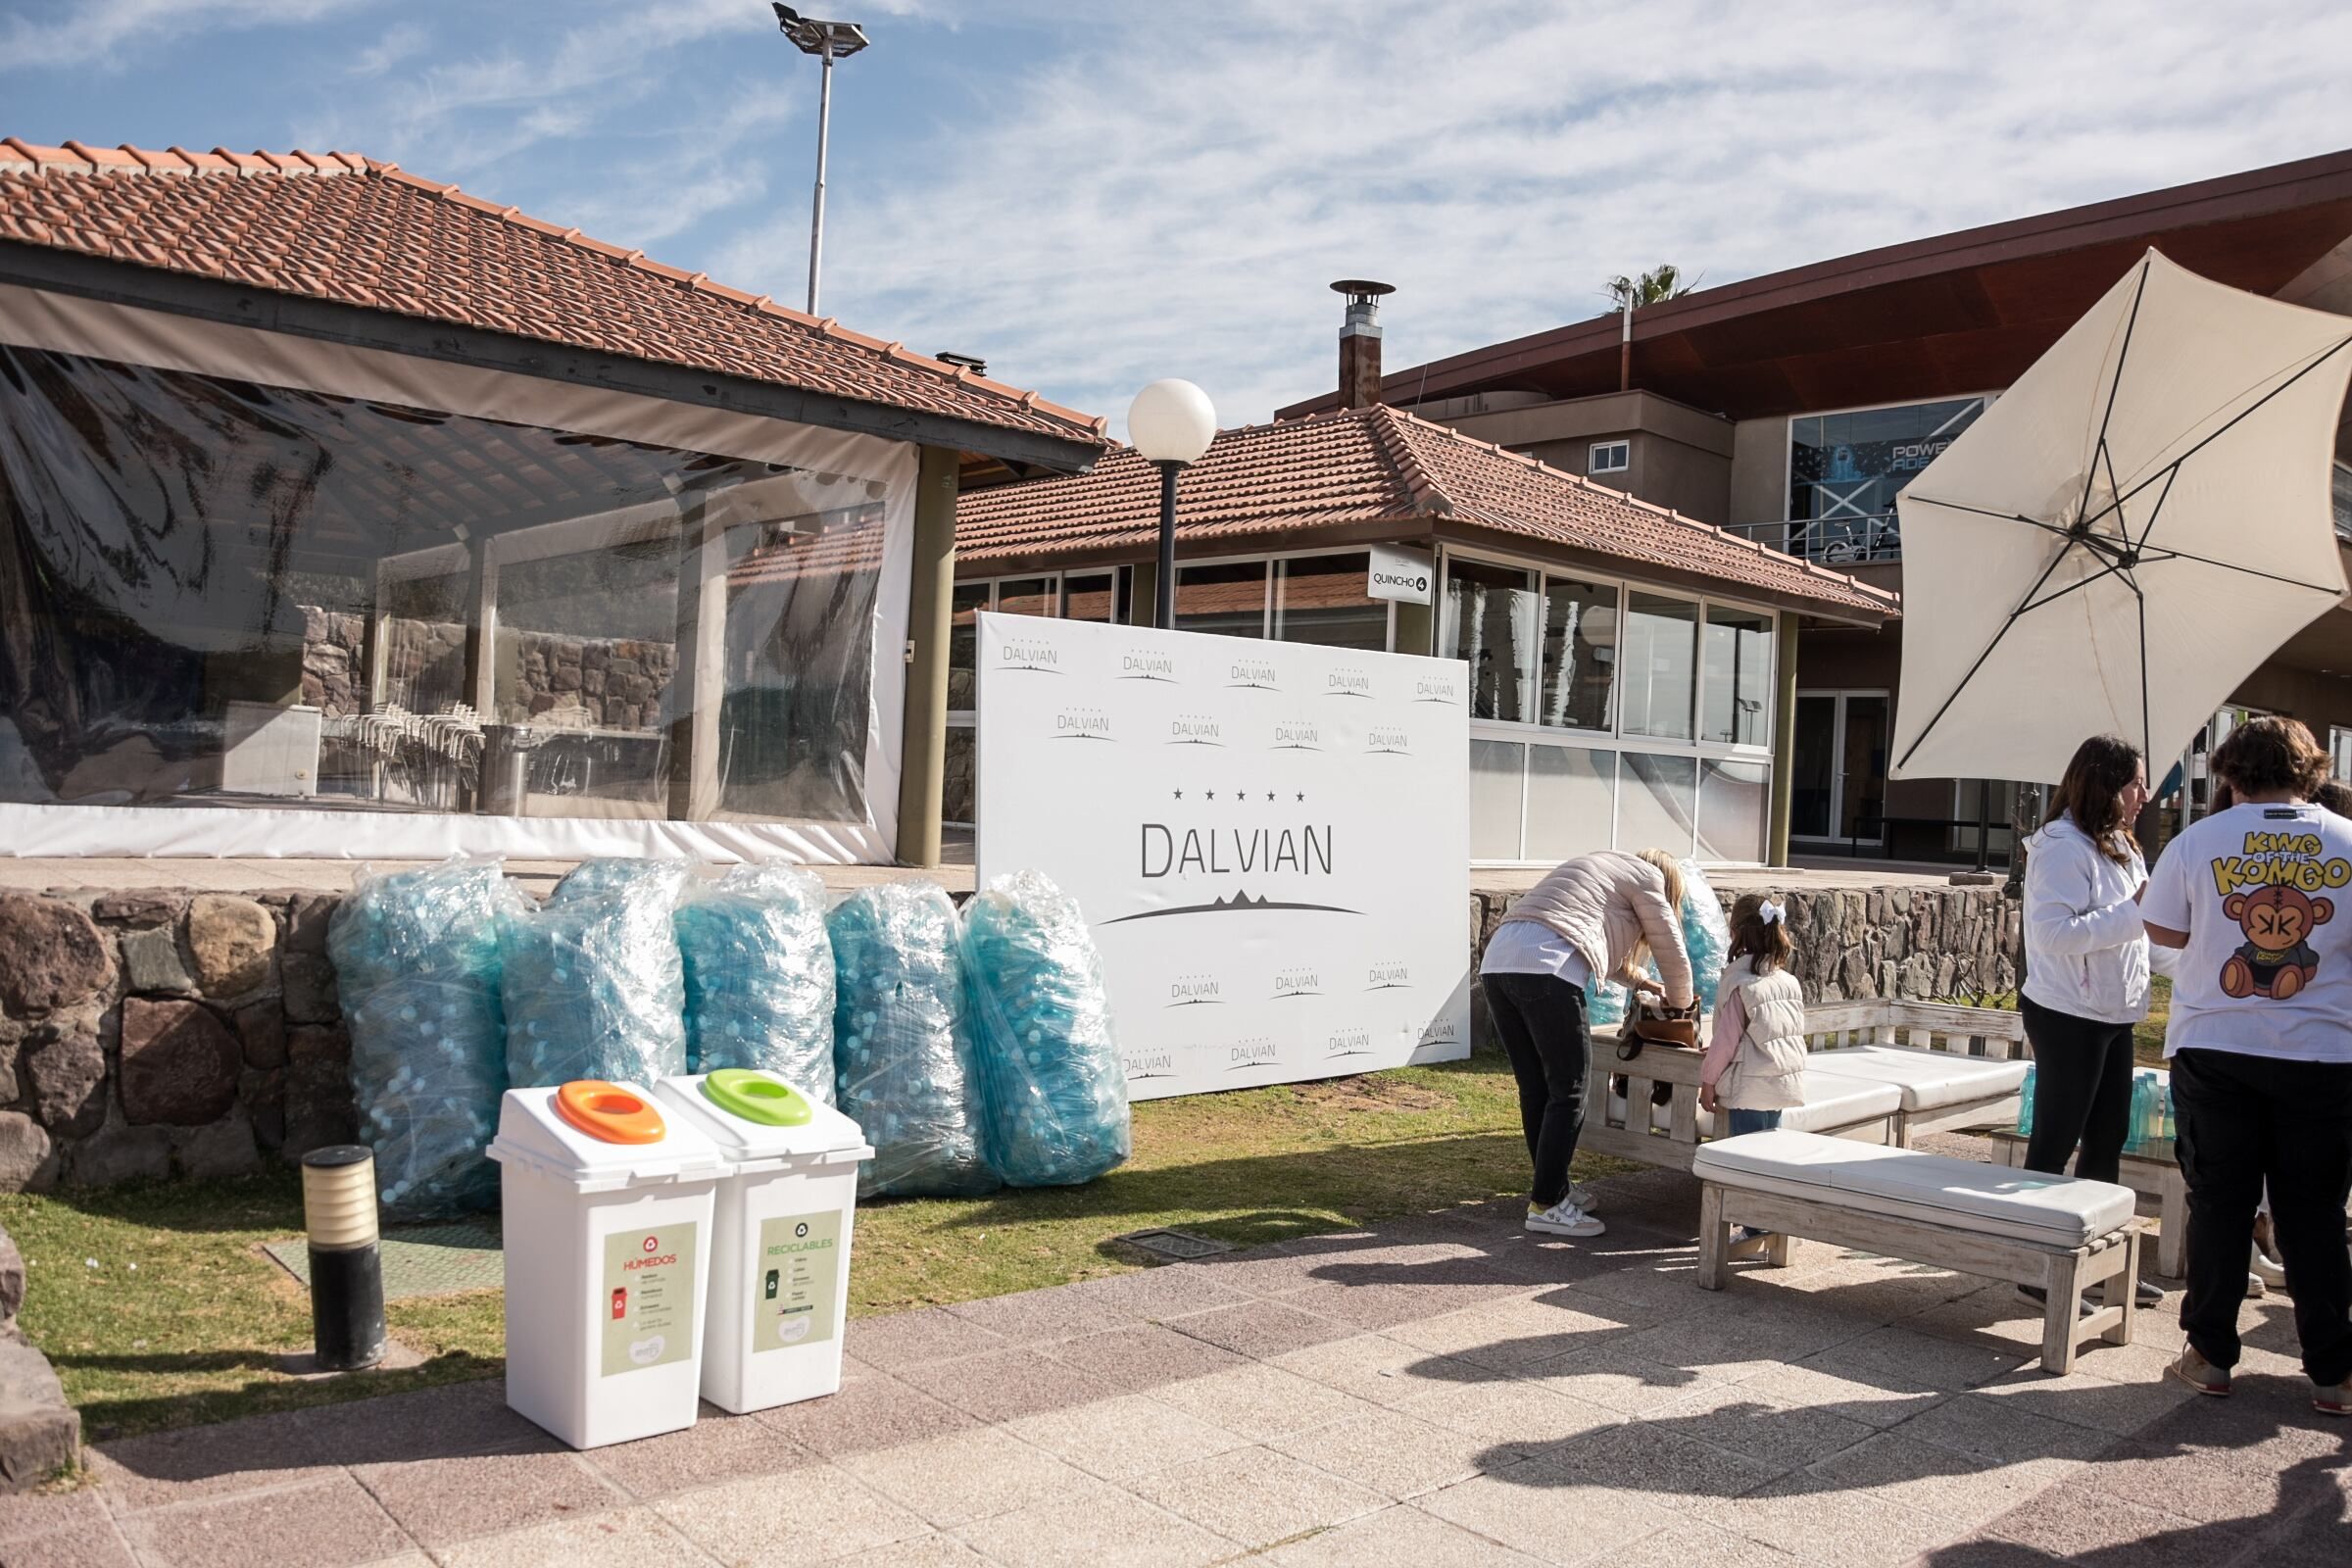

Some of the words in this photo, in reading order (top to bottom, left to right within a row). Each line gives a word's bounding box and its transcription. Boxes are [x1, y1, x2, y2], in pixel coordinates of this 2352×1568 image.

[1892, 442, 1950, 459] POWE
[1892, 457, 1930, 470] ADE
[1373, 572, 1414, 588] QUINCHO
[1417, 578, 1426, 590] 4
[1003, 645, 1057, 665] DALVIAN
[1123, 655, 1172, 675] DALVIAN
[1231, 664, 1276, 683] DALVIAN
[1328, 673, 1369, 691] DALVIAN
[1417, 681, 1454, 698] DALVIAN
[1057, 714, 1109, 731] DALVIAN
[1172, 721, 1219, 738] DALVIAN
[1276, 726, 1318, 743] DALVIAN
[1368, 732, 1407, 747] DALVIAN
[1142, 823, 1332, 879] DALVIAN
[2243, 831, 2322, 856] KING
[2252, 852, 2276, 864] OF
[2279, 851, 2311, 865] THE
[2211, 858, 2352, 896] KONGO
[1275, 973, 1318, 990] DALVIAN
[1369, 967, 1407, 983] DALVIAN
[1171, 982, 1219, 998] DALVIAN
[1417, 1024, 1454, 1040] DALVIAN
[1329, 1034, 1370, 1052] DALVIAN
[1231, 1044, 1276, 1061] DALVIAN
[767, 1239, 833, 1255] RECICLABLES
